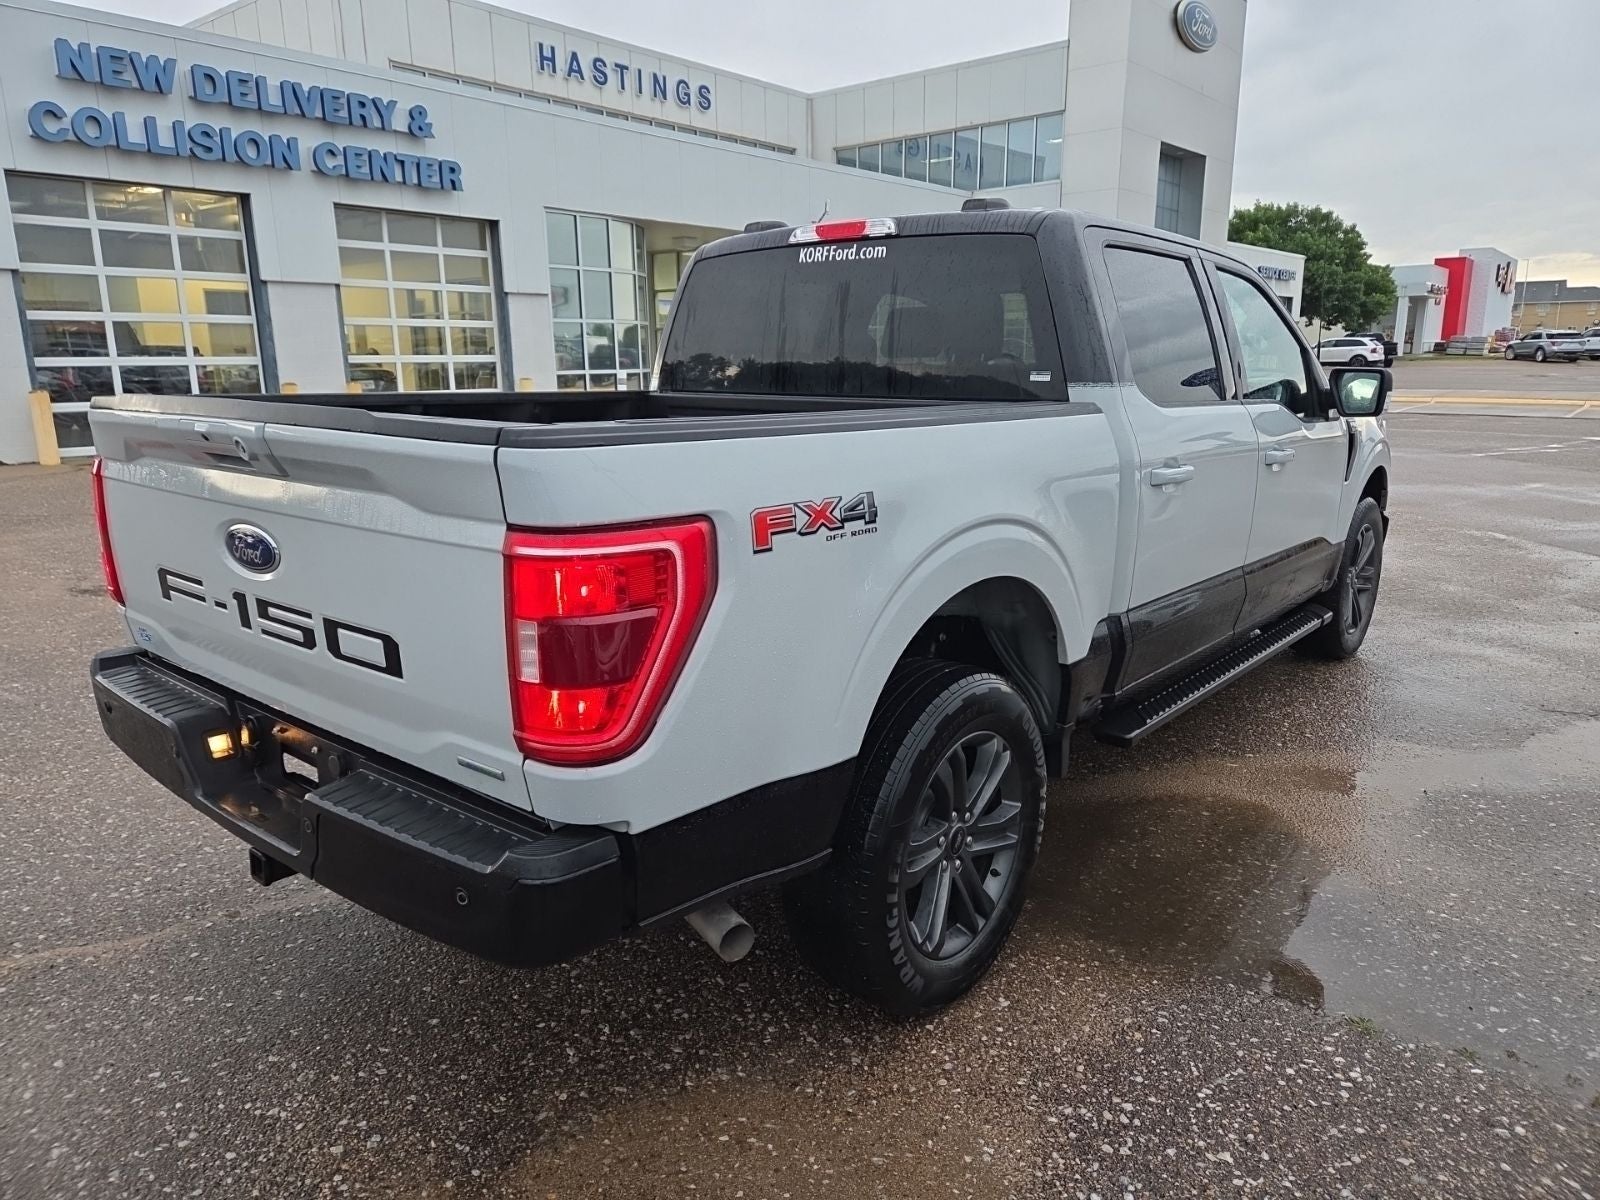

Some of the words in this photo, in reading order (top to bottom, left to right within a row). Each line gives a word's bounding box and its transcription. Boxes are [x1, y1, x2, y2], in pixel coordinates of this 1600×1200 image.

[1191, 7, 1214, 41] Ford
[54, 37, 177, 94] NEW
[189, 63, 398, 131] DELIVERY
[407, 104, 435, 139] &
[537, 41, 713, 111] HASTINGS
[28, 100, 301, 171] COLLISION
[312, 141, 464, 191] CENTER
[798, 243, 887, 264] KORFFord.com
[232, 533, 263, 564] Ford
[750, 490, 878, 555] FX4
[825, 532, 848, 542] OFF
[850, 526, 878, 538] ROAD
[156, 566, 404, 680] F-150
